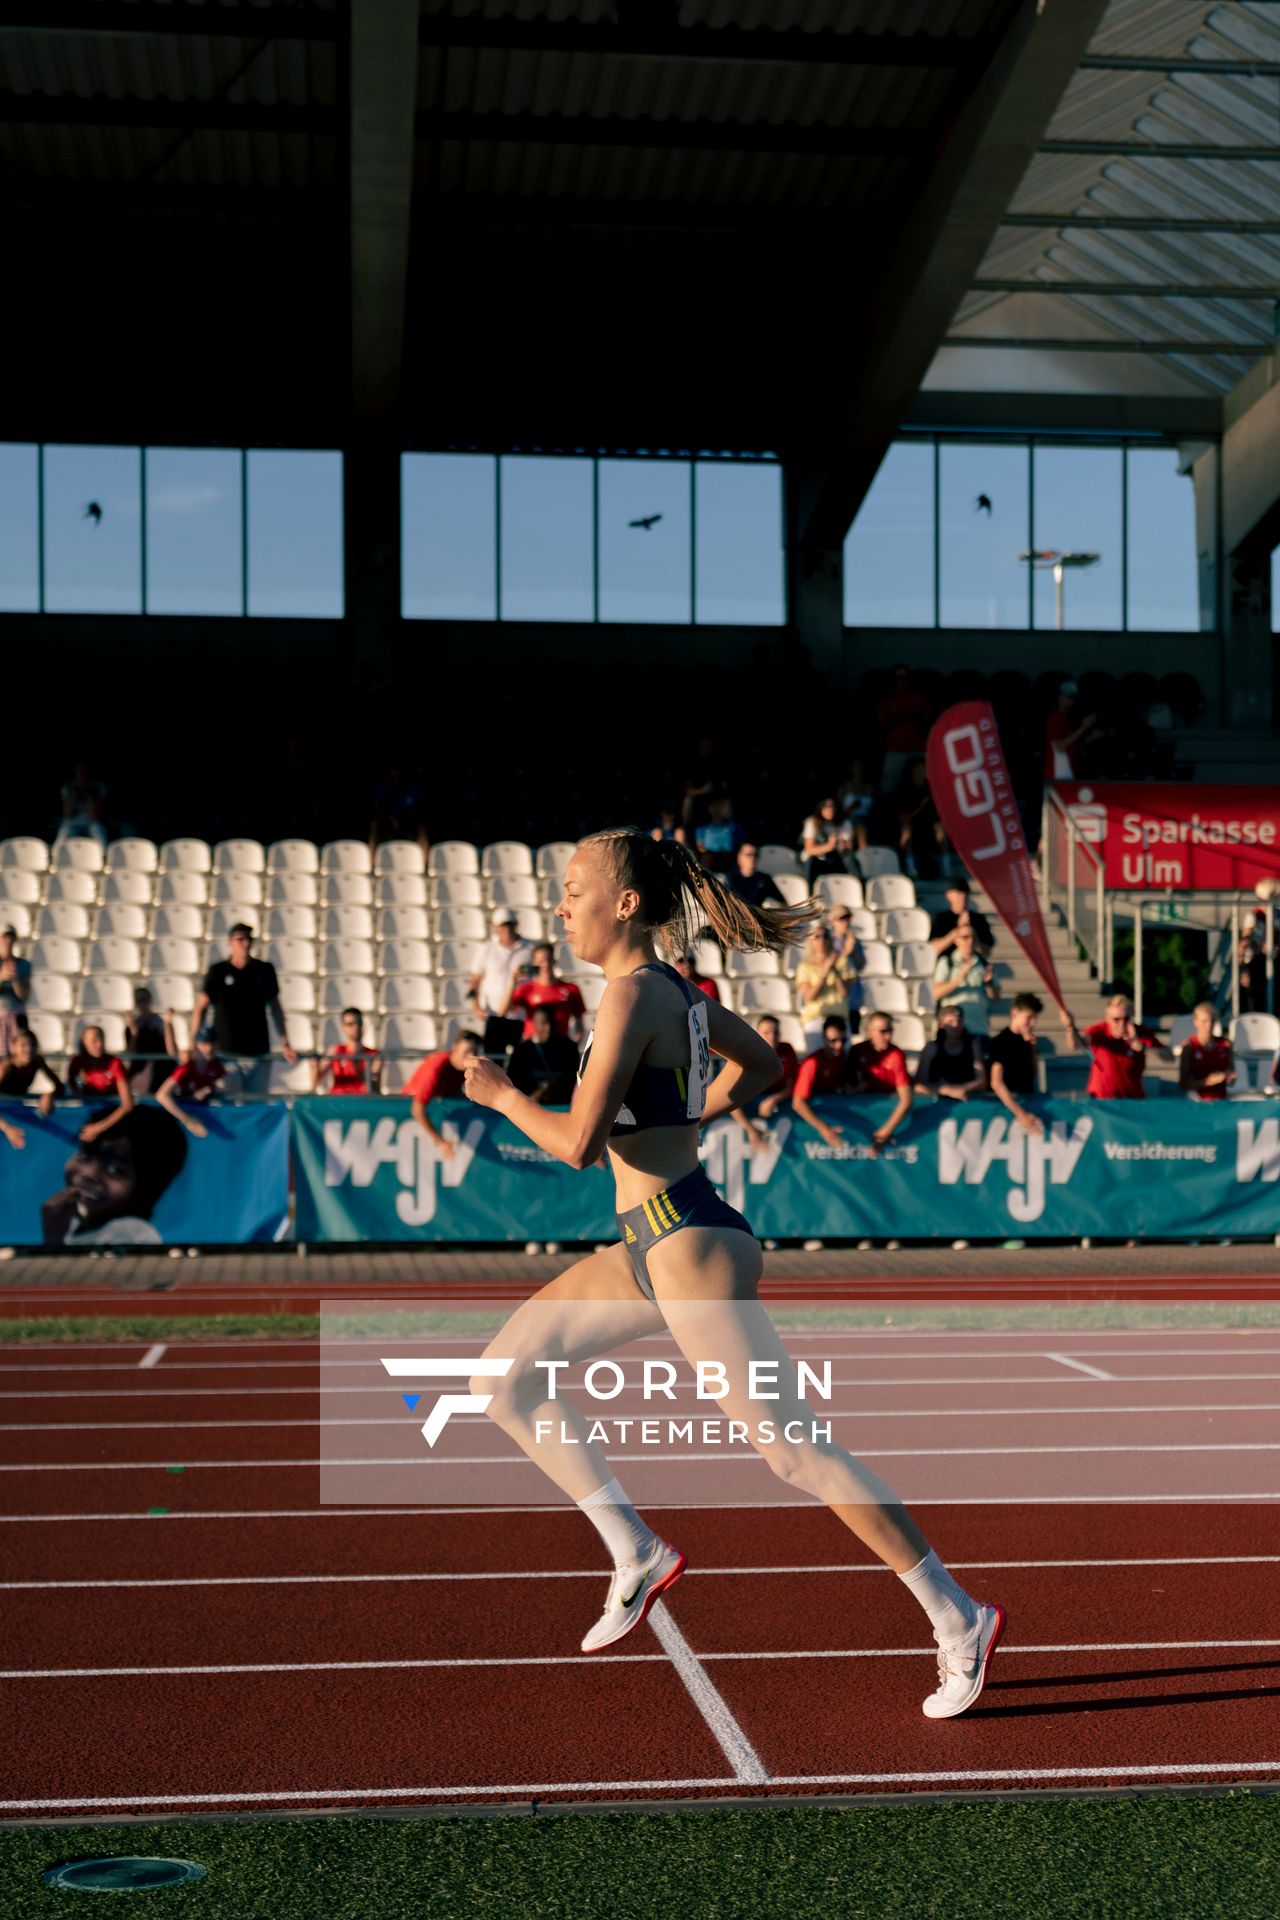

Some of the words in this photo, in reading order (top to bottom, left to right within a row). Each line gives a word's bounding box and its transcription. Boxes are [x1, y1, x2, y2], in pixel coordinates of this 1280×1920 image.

[1122, 813, 1276, 850] Sparkasse
[1122, 852, 1182, 883] Ulm
[1103, 1140, 1217, 1162] Versicherung
